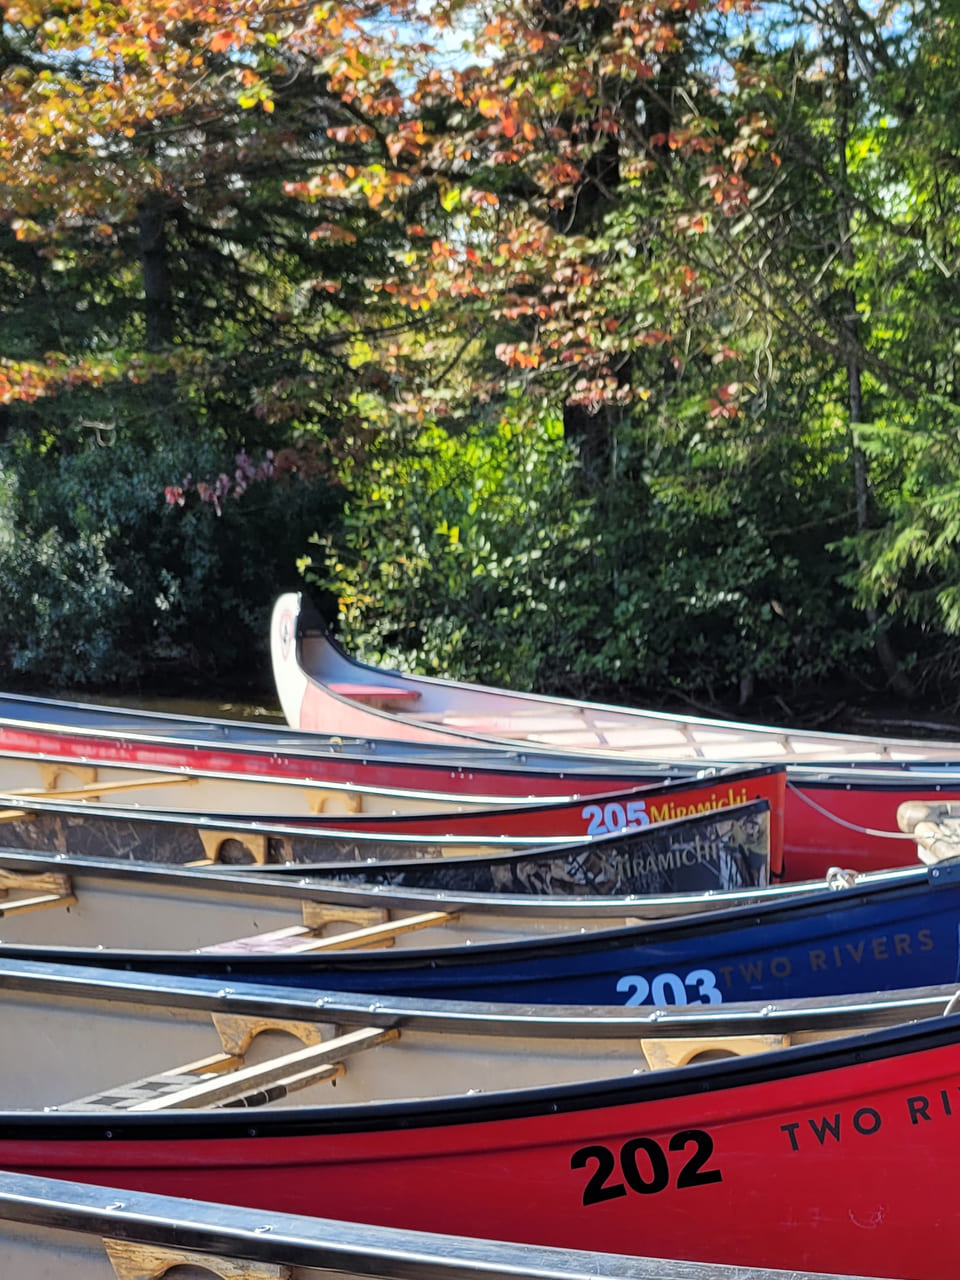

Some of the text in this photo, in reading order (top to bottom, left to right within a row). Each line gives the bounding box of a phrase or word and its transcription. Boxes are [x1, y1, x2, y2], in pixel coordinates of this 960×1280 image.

[581, 800, 650, 836] 205
[616, 930, 934, 1006] 203 TWO RIVERS
[570, 1129, 723, 1207] 202
[780, 1107, 882, 1152] TWO
